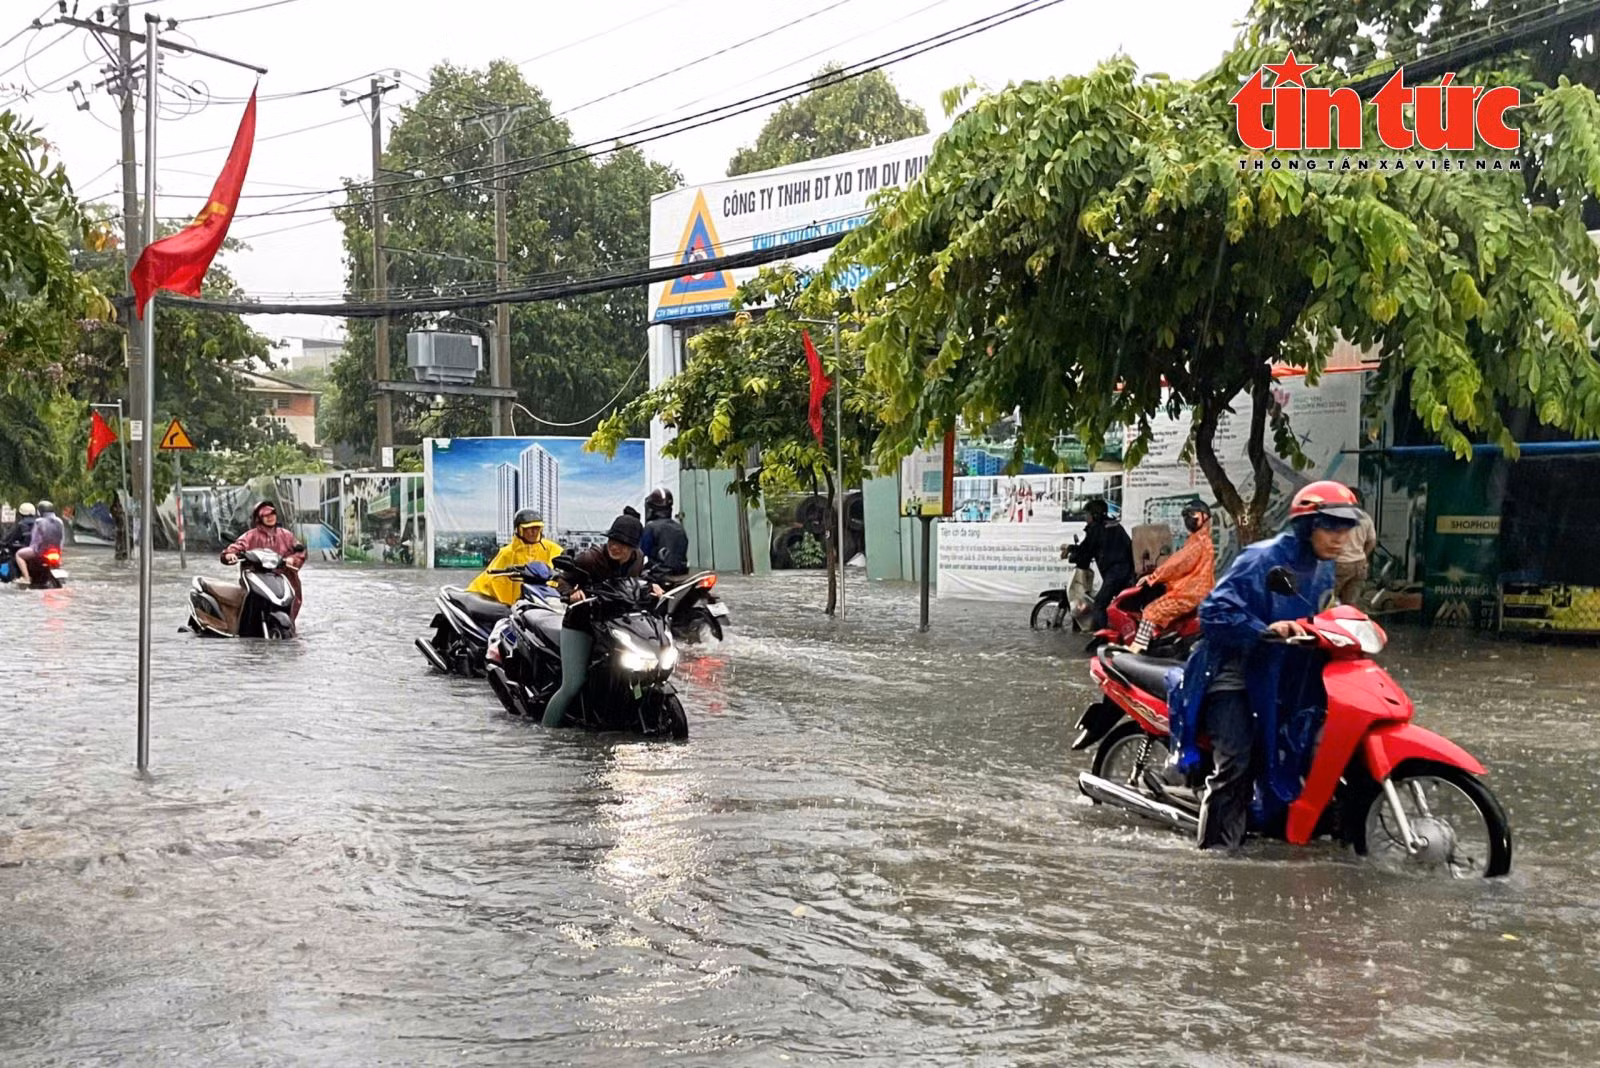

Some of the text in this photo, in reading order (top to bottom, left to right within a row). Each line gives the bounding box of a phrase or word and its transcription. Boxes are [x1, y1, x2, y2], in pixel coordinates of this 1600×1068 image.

[723, 189, 756, 218] CÔNG
[760, 186, 774, 210] TY
[777, 179, 810, 207] TNHH
[814, 175, 831, 200] ĐT
[834, 171, 852, 197] XD
[857, 165, 877, 192] TM
[882, 160, 900, 187] DV
[1450, 519, 1499, 530] SHOPHOU
